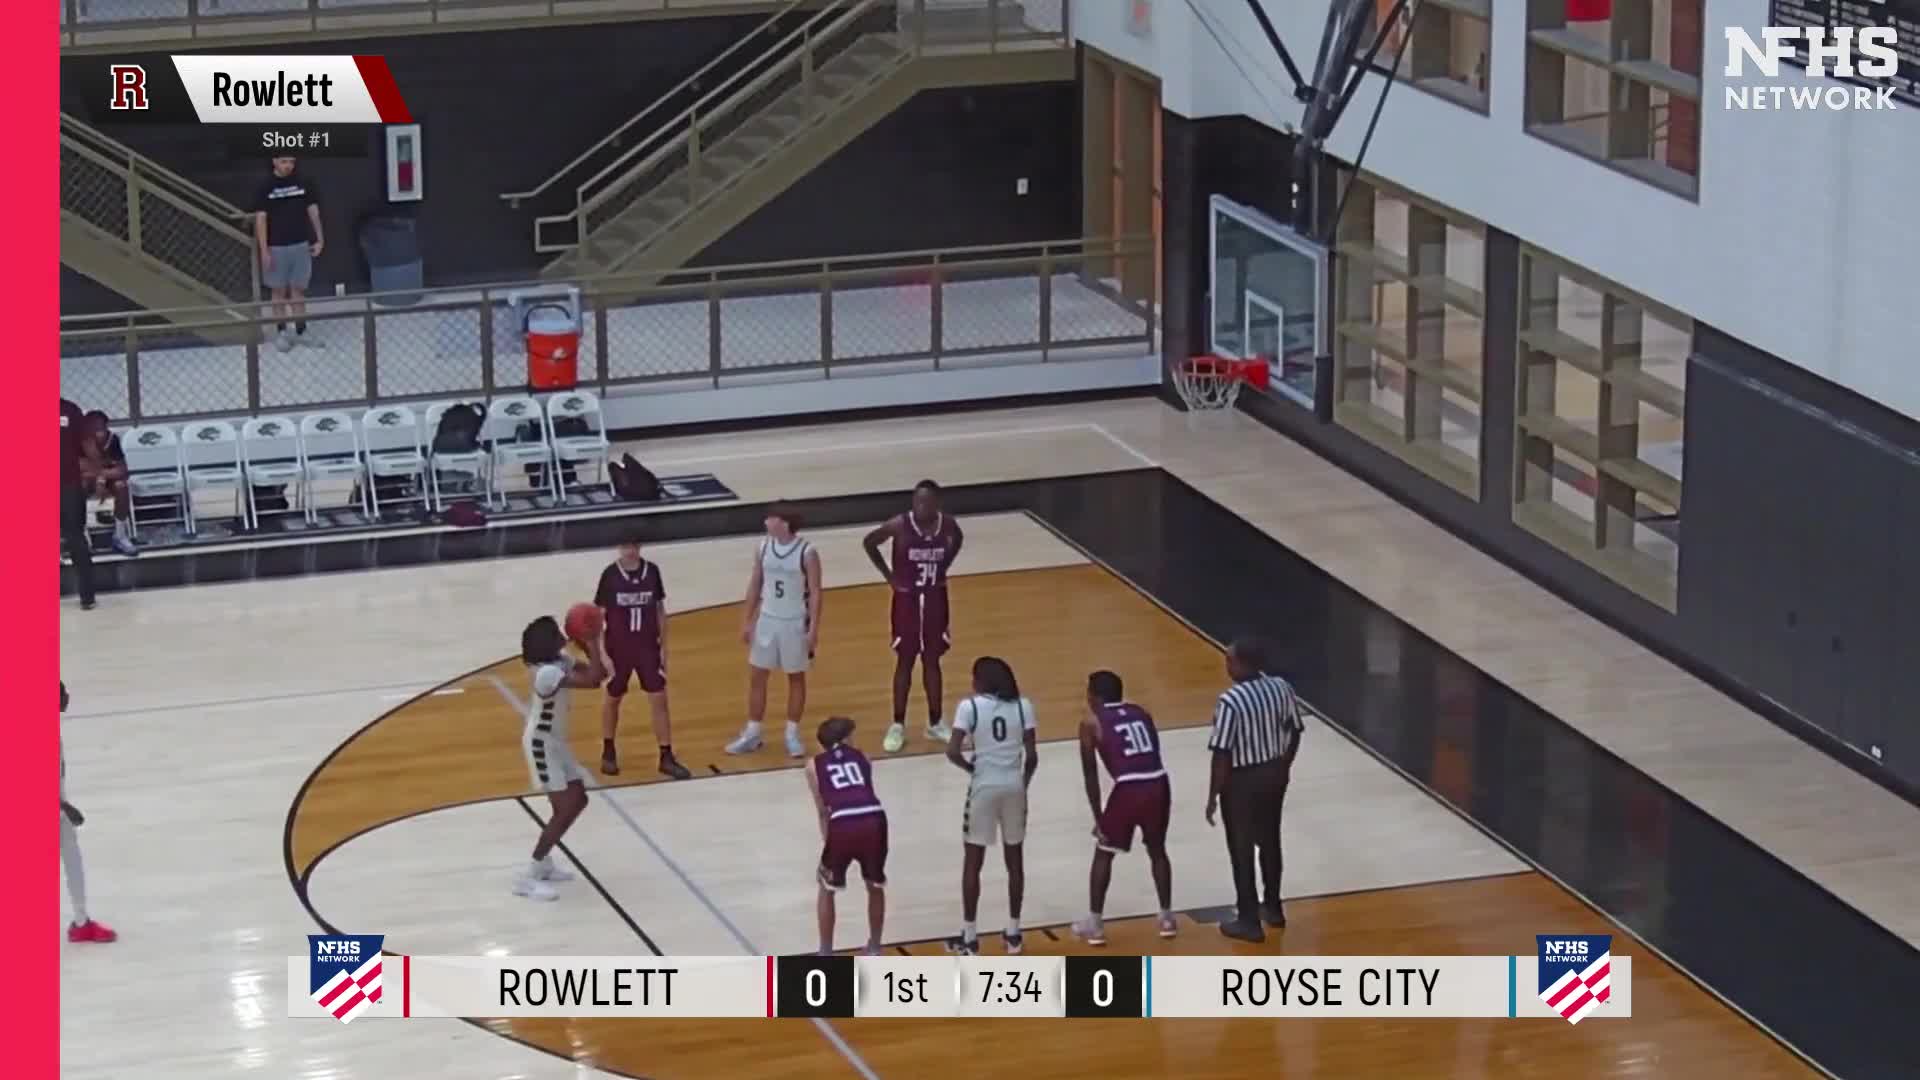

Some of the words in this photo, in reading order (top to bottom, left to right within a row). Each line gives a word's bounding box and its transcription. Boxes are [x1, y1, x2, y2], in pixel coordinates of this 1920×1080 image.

[915, 563, 938, 586] 34
[775, 580, 785, 599] 5
[630, 607, 642, 632] 11
[992, 715, 1007, 742] 0
[1114, 720, 1153, 756] 30
[827, 762, 865, 789] 20
